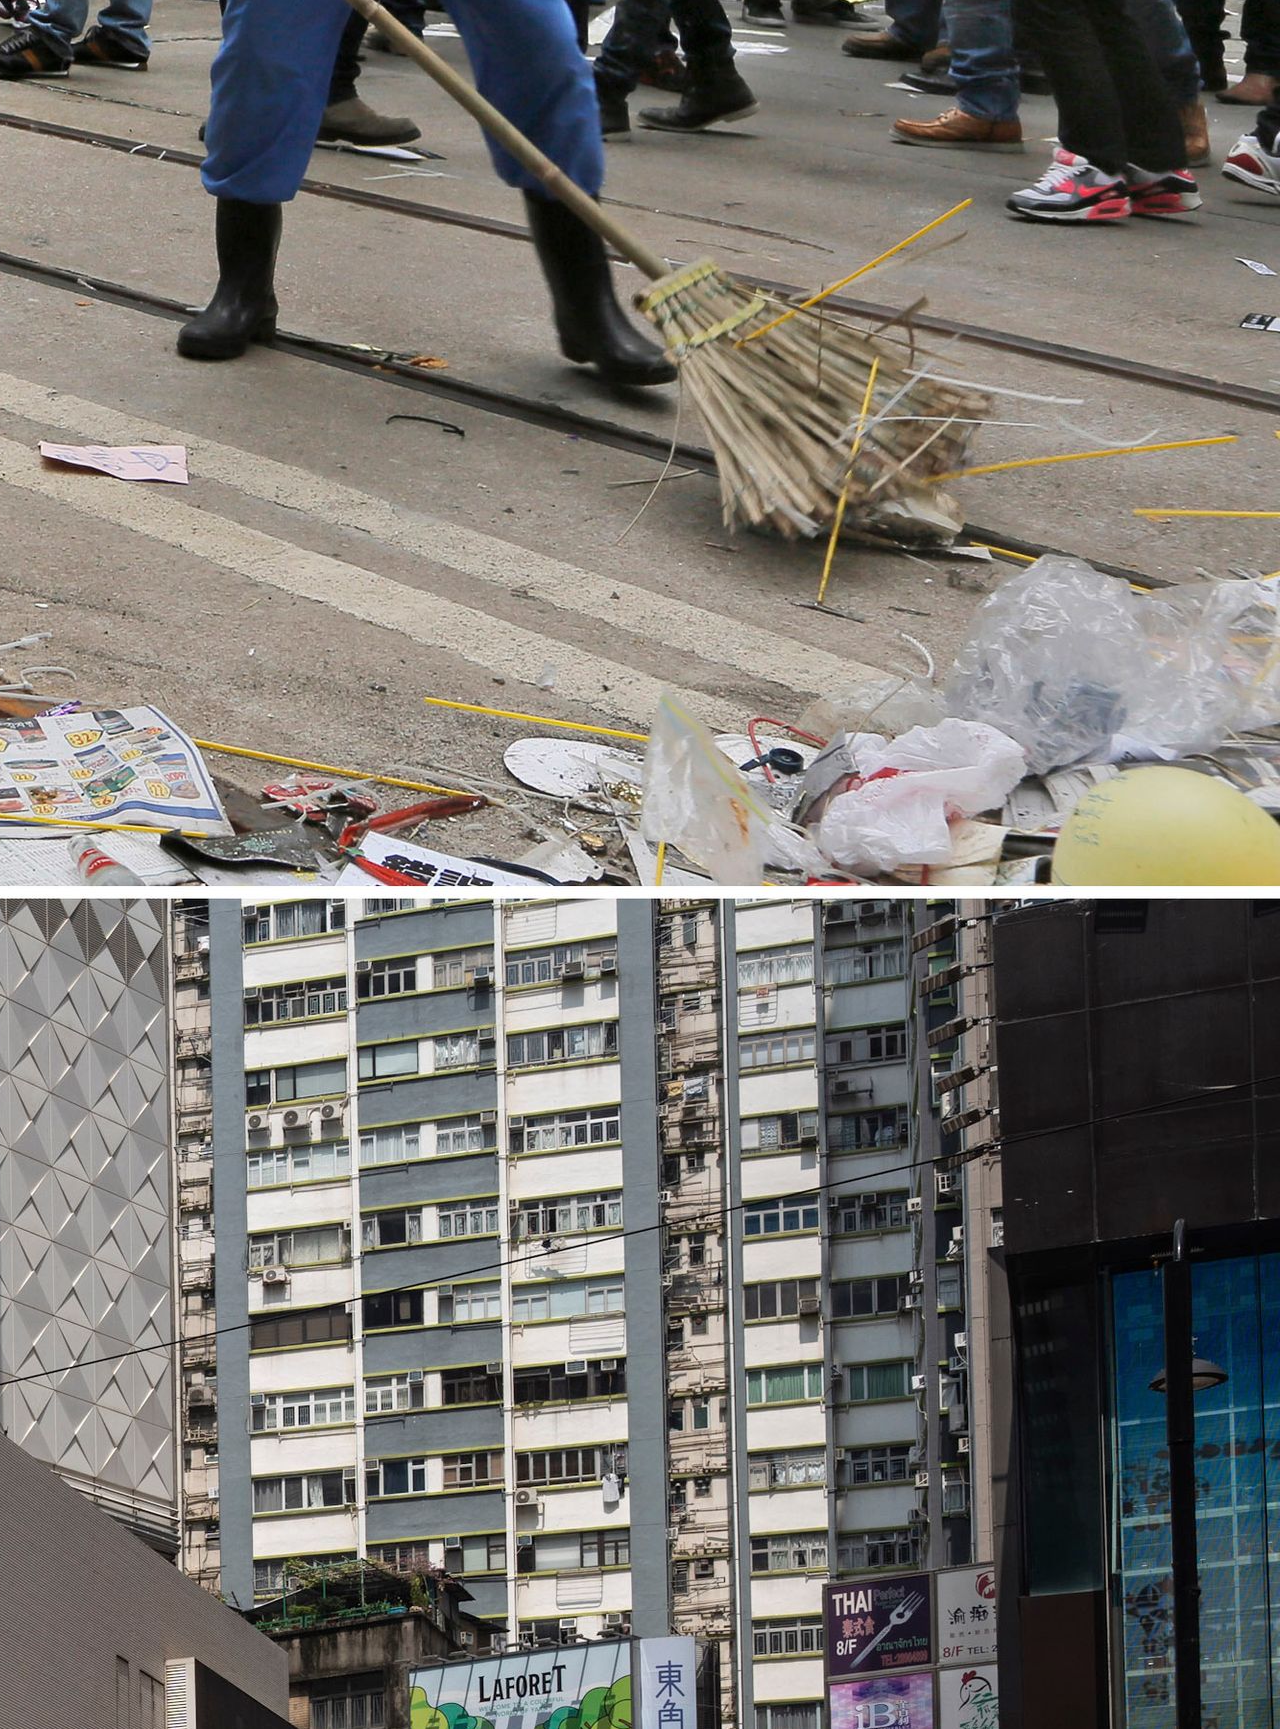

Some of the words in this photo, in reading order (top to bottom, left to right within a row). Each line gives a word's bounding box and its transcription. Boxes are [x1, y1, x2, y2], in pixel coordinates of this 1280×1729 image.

[831, 1589, 873, 1617] THAI
[873, 1585, 905, 1603] Perfect
[836, 1638, 858, 1656] 8/F
[942, 1645, 964, 1658] 8/F
[967, 1645, 989, 1655] TEL:
[478, 1664, 567, 1704] LAFORET
